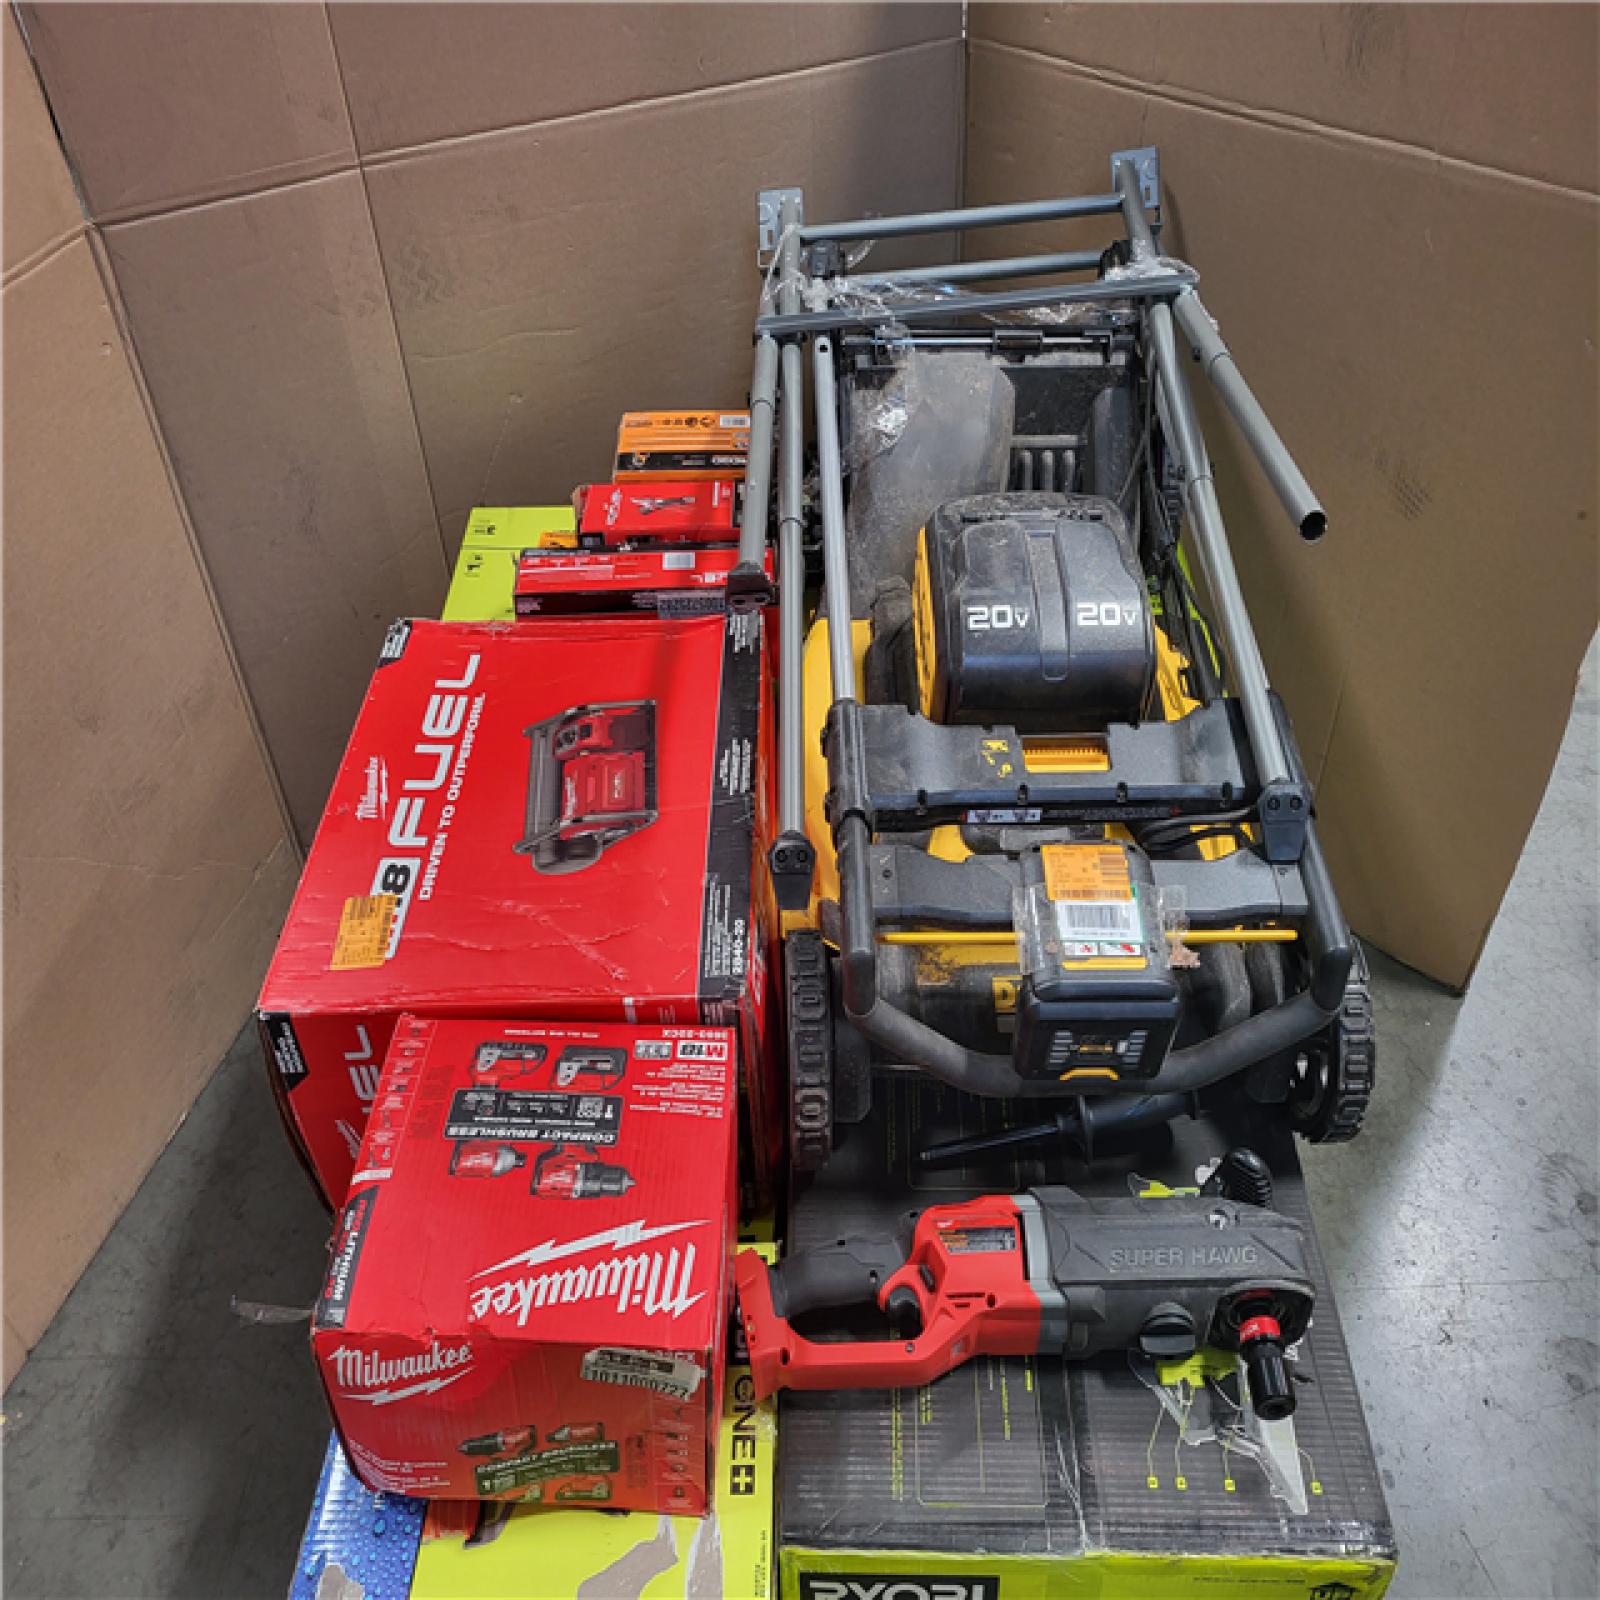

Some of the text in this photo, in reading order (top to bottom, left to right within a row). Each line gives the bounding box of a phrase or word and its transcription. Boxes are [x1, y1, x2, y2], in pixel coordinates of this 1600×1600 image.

[388, 654, 481, 847] FUEL
[419, 832, 447, 901] DRIVEN
[437, 805, 456, 829] TO
[467, 1242, 708, 1326] Milwaukee
[1109, 1245, 1259, 1273] SUPER HAWG
[327, 1339, 474, 1388] Milwaukee
